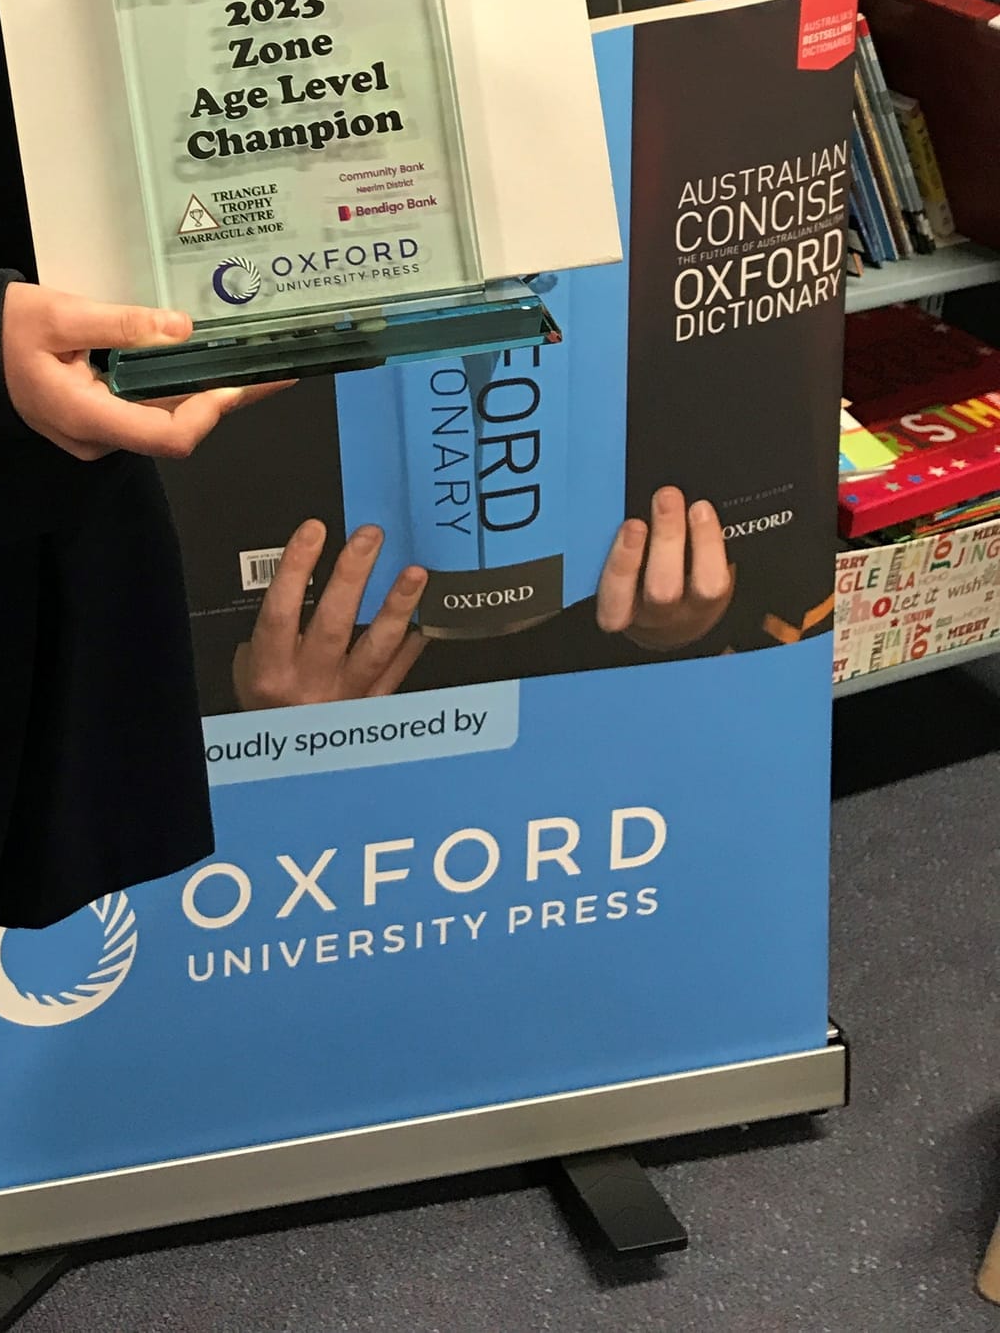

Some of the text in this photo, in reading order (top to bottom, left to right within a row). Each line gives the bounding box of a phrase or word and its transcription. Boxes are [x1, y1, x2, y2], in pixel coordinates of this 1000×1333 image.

[229, 34, 334, 69] Zone
[189, 61, 390, 121] Age Level
[186, 108, 405, 160] Champion
[338, 162, 425, 182] Community Bank
[386, 179, 414, 190] District
[678, 140, 847, 210] AUSTRALIAN
[211, 183, 278, 203] TRIANGLE
[219, 197, 273, 214] TROPHY
[356, 195, 437, 217] Bendigo Bank
[222, 209, 275, 226] CENTRE
[675, 170, 847, 253] CONCISE
[179, 222, 284, 246] WARRAGUL & MOE
[677, 254, 697, 266] THE
[700, 245, 739, 263] FUTURE
[742, 241, 754, 252] OF
[757, 228, 812, 249] AUSTRALIAN
[272, 238, 419, 277] OXFORD
[674, 229, 843, 311] OXFORD
[276, 263, 420, 293] UNIVERSITY PRESS
[676, 268, 841, 342] DICTIONARY
[722, 510, 793, 539] OXFORD
[443, 585, 534, 609] OXFORD
[294, 710, 446, 756] sponsored
[454, 708, 488, 736] by
[181, 805, 667, 930] OXFORD
[188, 886, 661, 983] UNIVERSITY PRESS
